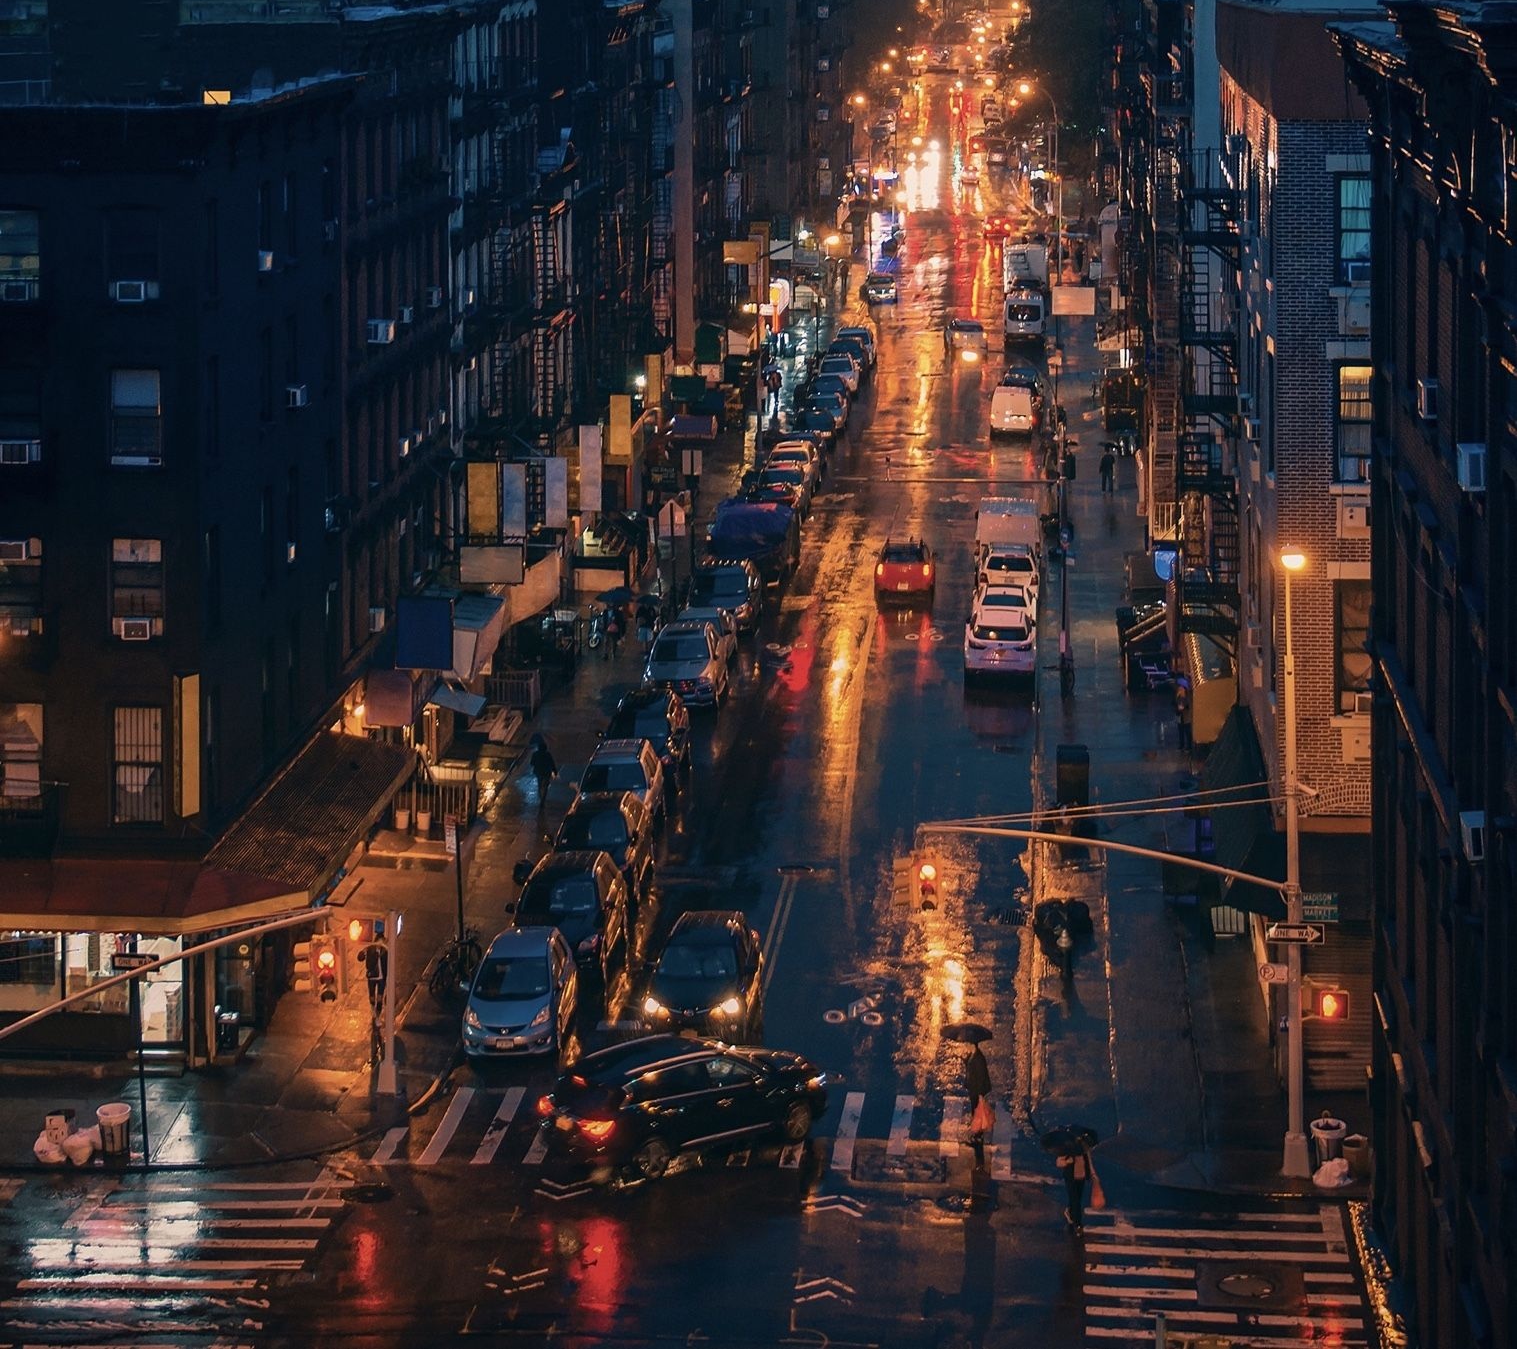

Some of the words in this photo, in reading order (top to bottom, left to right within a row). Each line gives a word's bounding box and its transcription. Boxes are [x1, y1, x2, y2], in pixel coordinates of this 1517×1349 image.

[1303, 892, 1332, 901] MADISON
[1274, 929, 1288, 938] ONE
[1298, 930, 1314, 939] WAY
